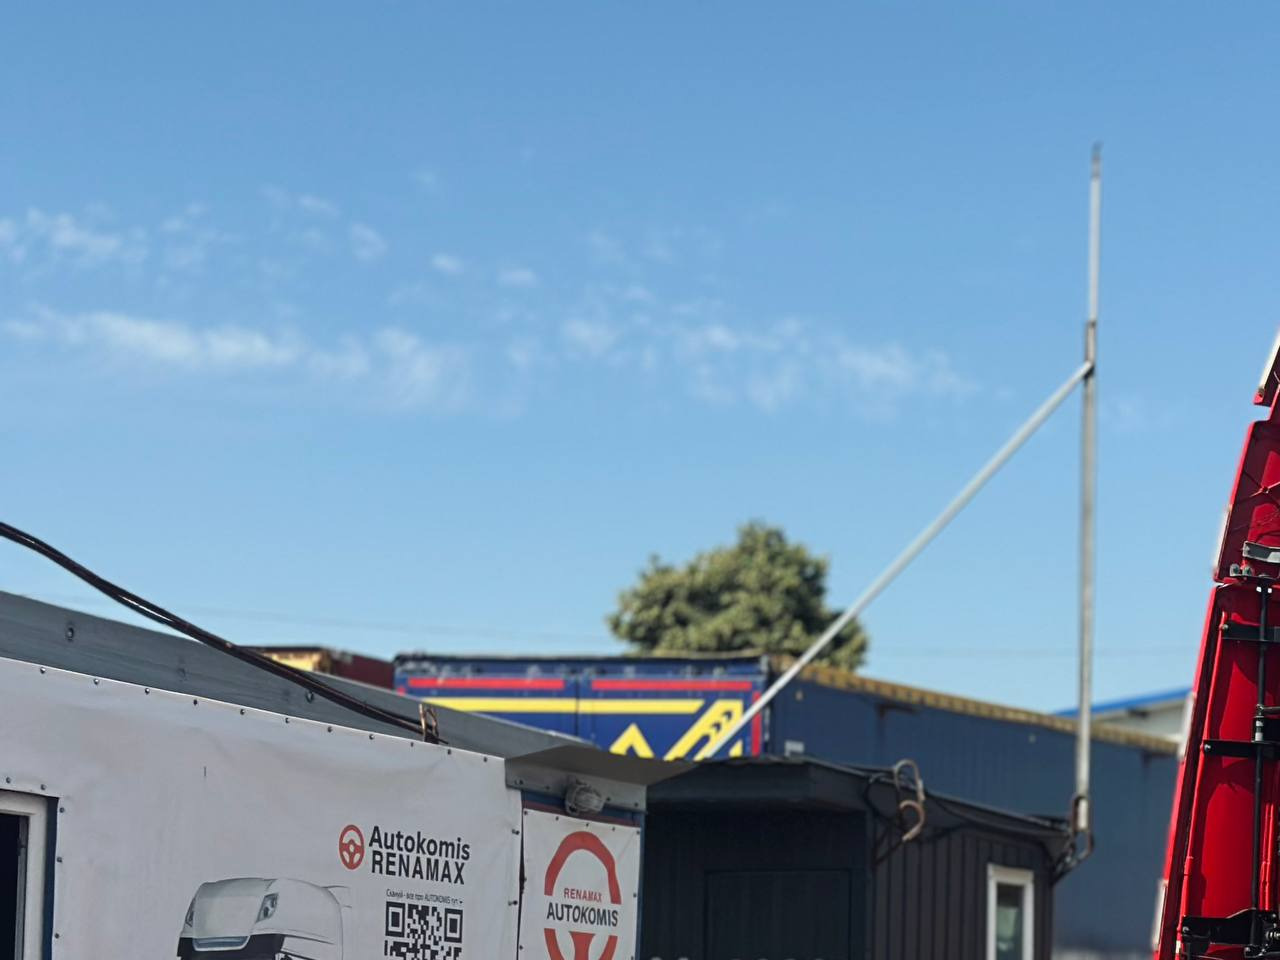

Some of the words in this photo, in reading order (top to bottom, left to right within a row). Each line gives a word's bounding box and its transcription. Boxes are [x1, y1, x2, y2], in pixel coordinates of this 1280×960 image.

[368, 825, 471, 861] Autokomis
[371, 850, 465, 885] RENAMAX
[563, 887, 603, 903] RENAMAX
[546, 901, 619, 927] AUTOKOMIS
